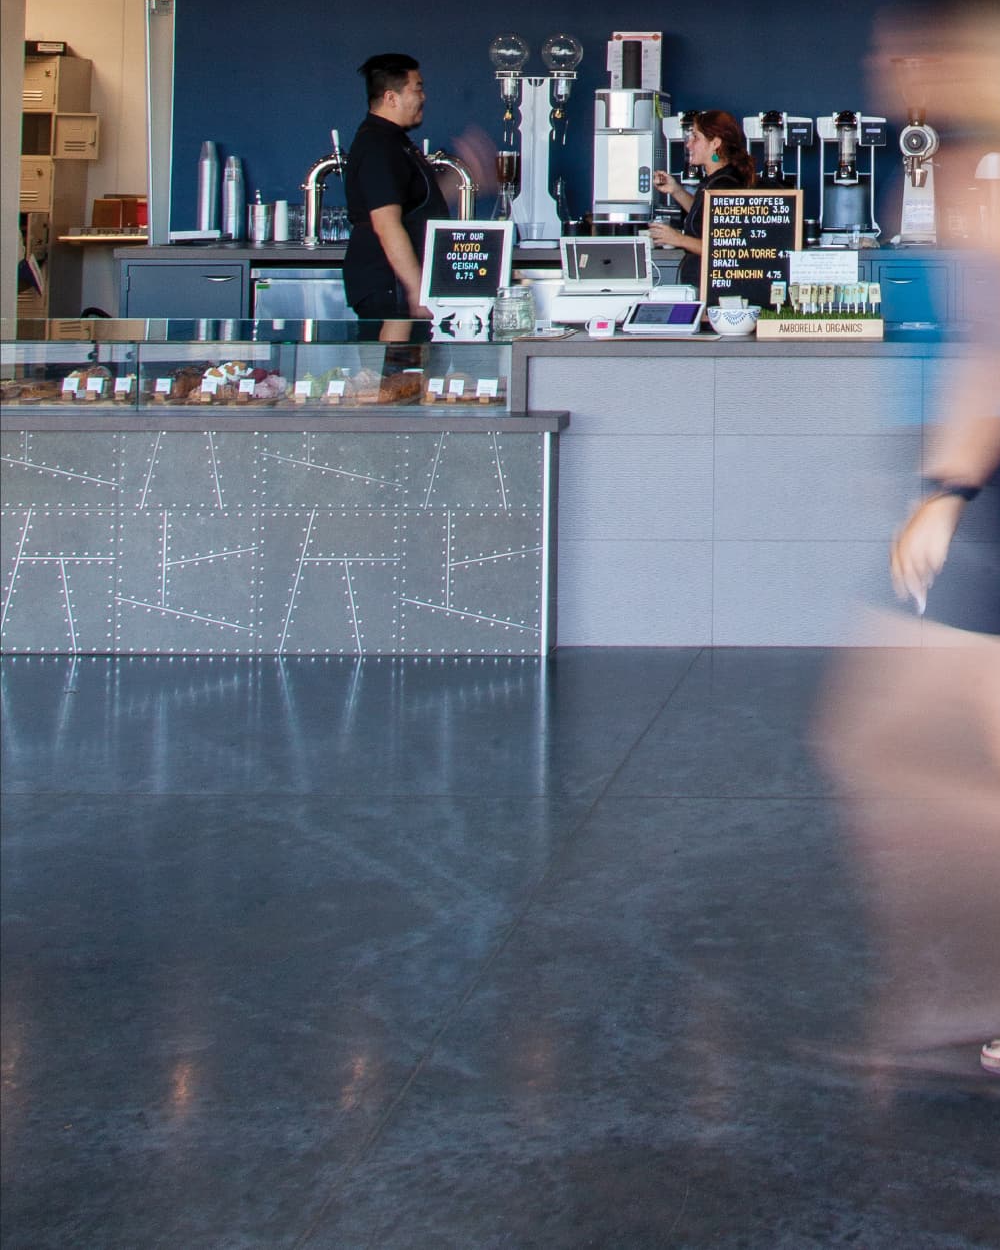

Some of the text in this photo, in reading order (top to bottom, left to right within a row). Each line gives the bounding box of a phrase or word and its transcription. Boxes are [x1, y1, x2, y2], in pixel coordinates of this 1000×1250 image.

[714, 206, 769, 215] ALCHEMISTIC
[714, 229, 766, 238] DECAF 3.75
[713, 238, 746, 246] SUMATRA
[713, 250, 736, 258] SITIO
[738, 250, 749, 258] DA
[751, 249, 776, 258] TORRE
[713, 270, 724, 278] EL
[725, 270, 763, 278] CHINCHIN
[779, 323, 863, 333] AMBORELLA ORGANICS
